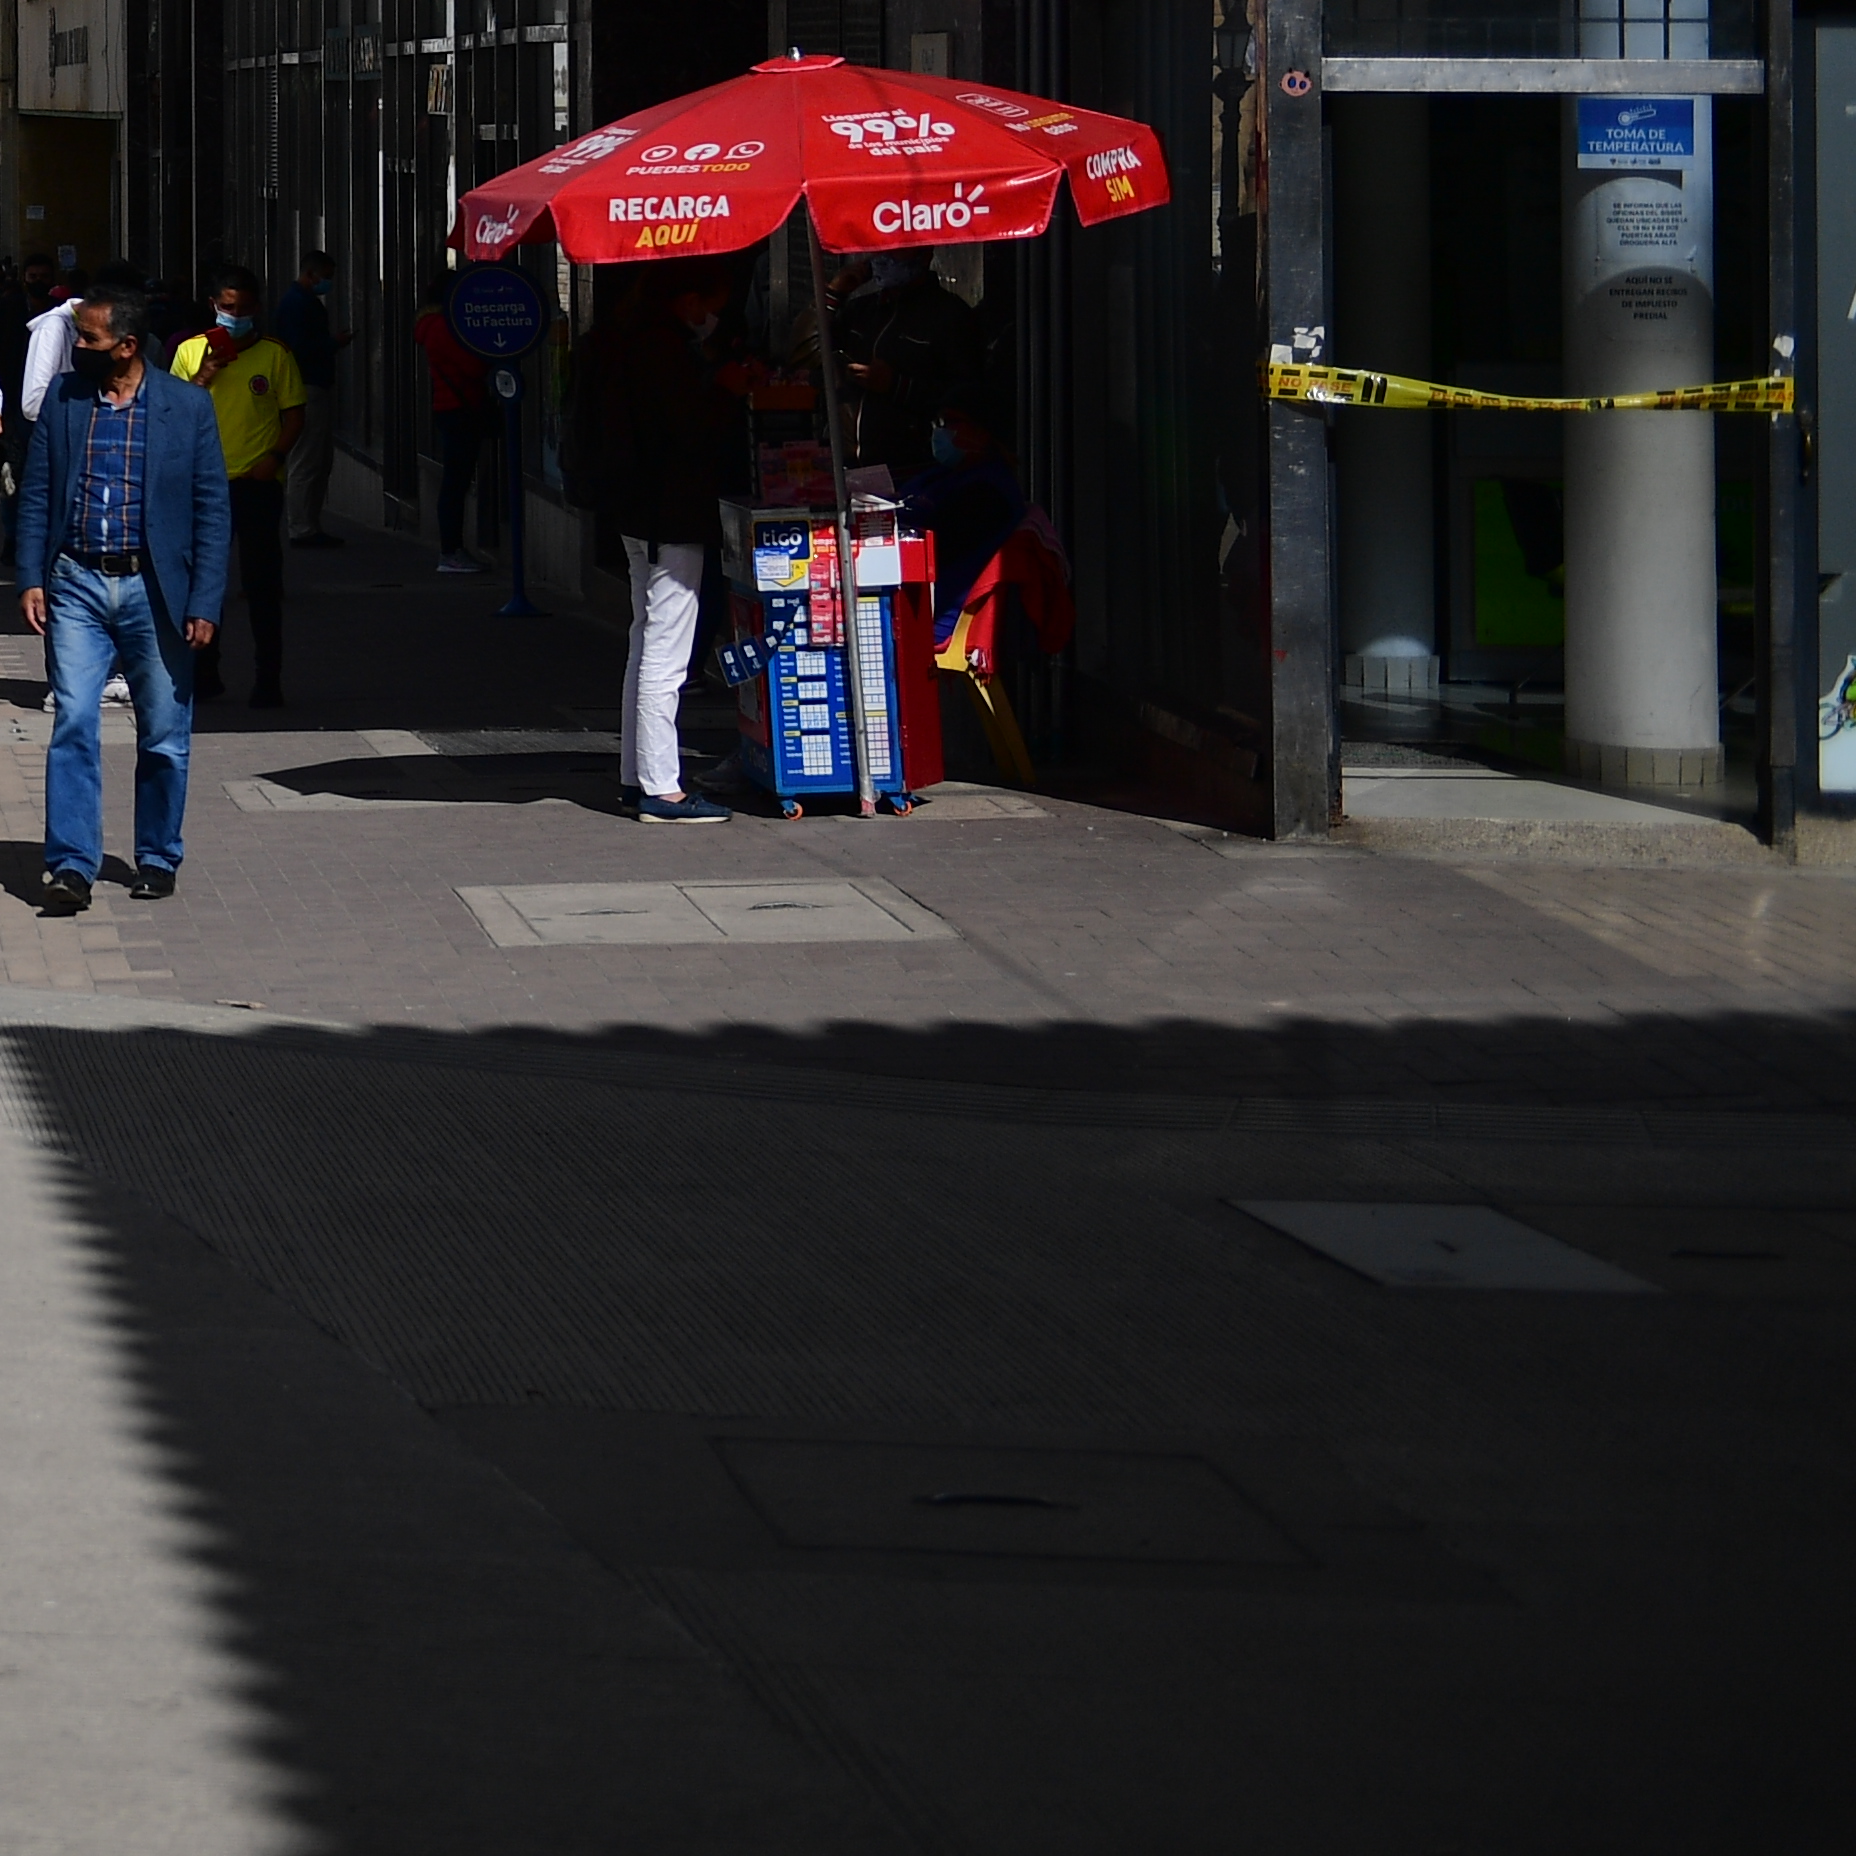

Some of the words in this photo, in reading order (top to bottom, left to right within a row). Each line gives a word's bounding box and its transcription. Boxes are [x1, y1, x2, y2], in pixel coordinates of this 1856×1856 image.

[821, 110, 891, 123] Llegamos
[891, 108, 907, 116] al
[830, 112, 956, 143] 99%
[1606, 128, 1646, 140] TOMA
[1649, 129, 1666, 140] DE
[884, 136, 951, 147] municipios
[1587, 140, 1685, 153] TEMPERATURA
[869, 146, 902, 156] del
[902, 144, 943, 156] país
[1086, 144, 1142, 180] COMPRA
[1105, 174, 1135, 203] SIM
[608, 195, 730, 222] RECARGA
[872, 198, 971, 234] Claro
[635, 218, 700, 249] AQUÍ
[1649, 275, 1663, 285] NO
[1609, 287, 1655, 296] ENTREGAN
[464, 301, 526, 315] Descarga
[1621, 300, 1633, 308] DE
[1635, 300, 1678, 308] IMPUESTO
[464, 317, 481, 328] Tu
[483, 316, 533, 328] Factura
[1633, 311, 1668, 320] PREDIAL
[1278, 376, 1302, 388] NO
[1308, 380, 1353, 392] PASE
[762, 528, 803, 552] tigo
